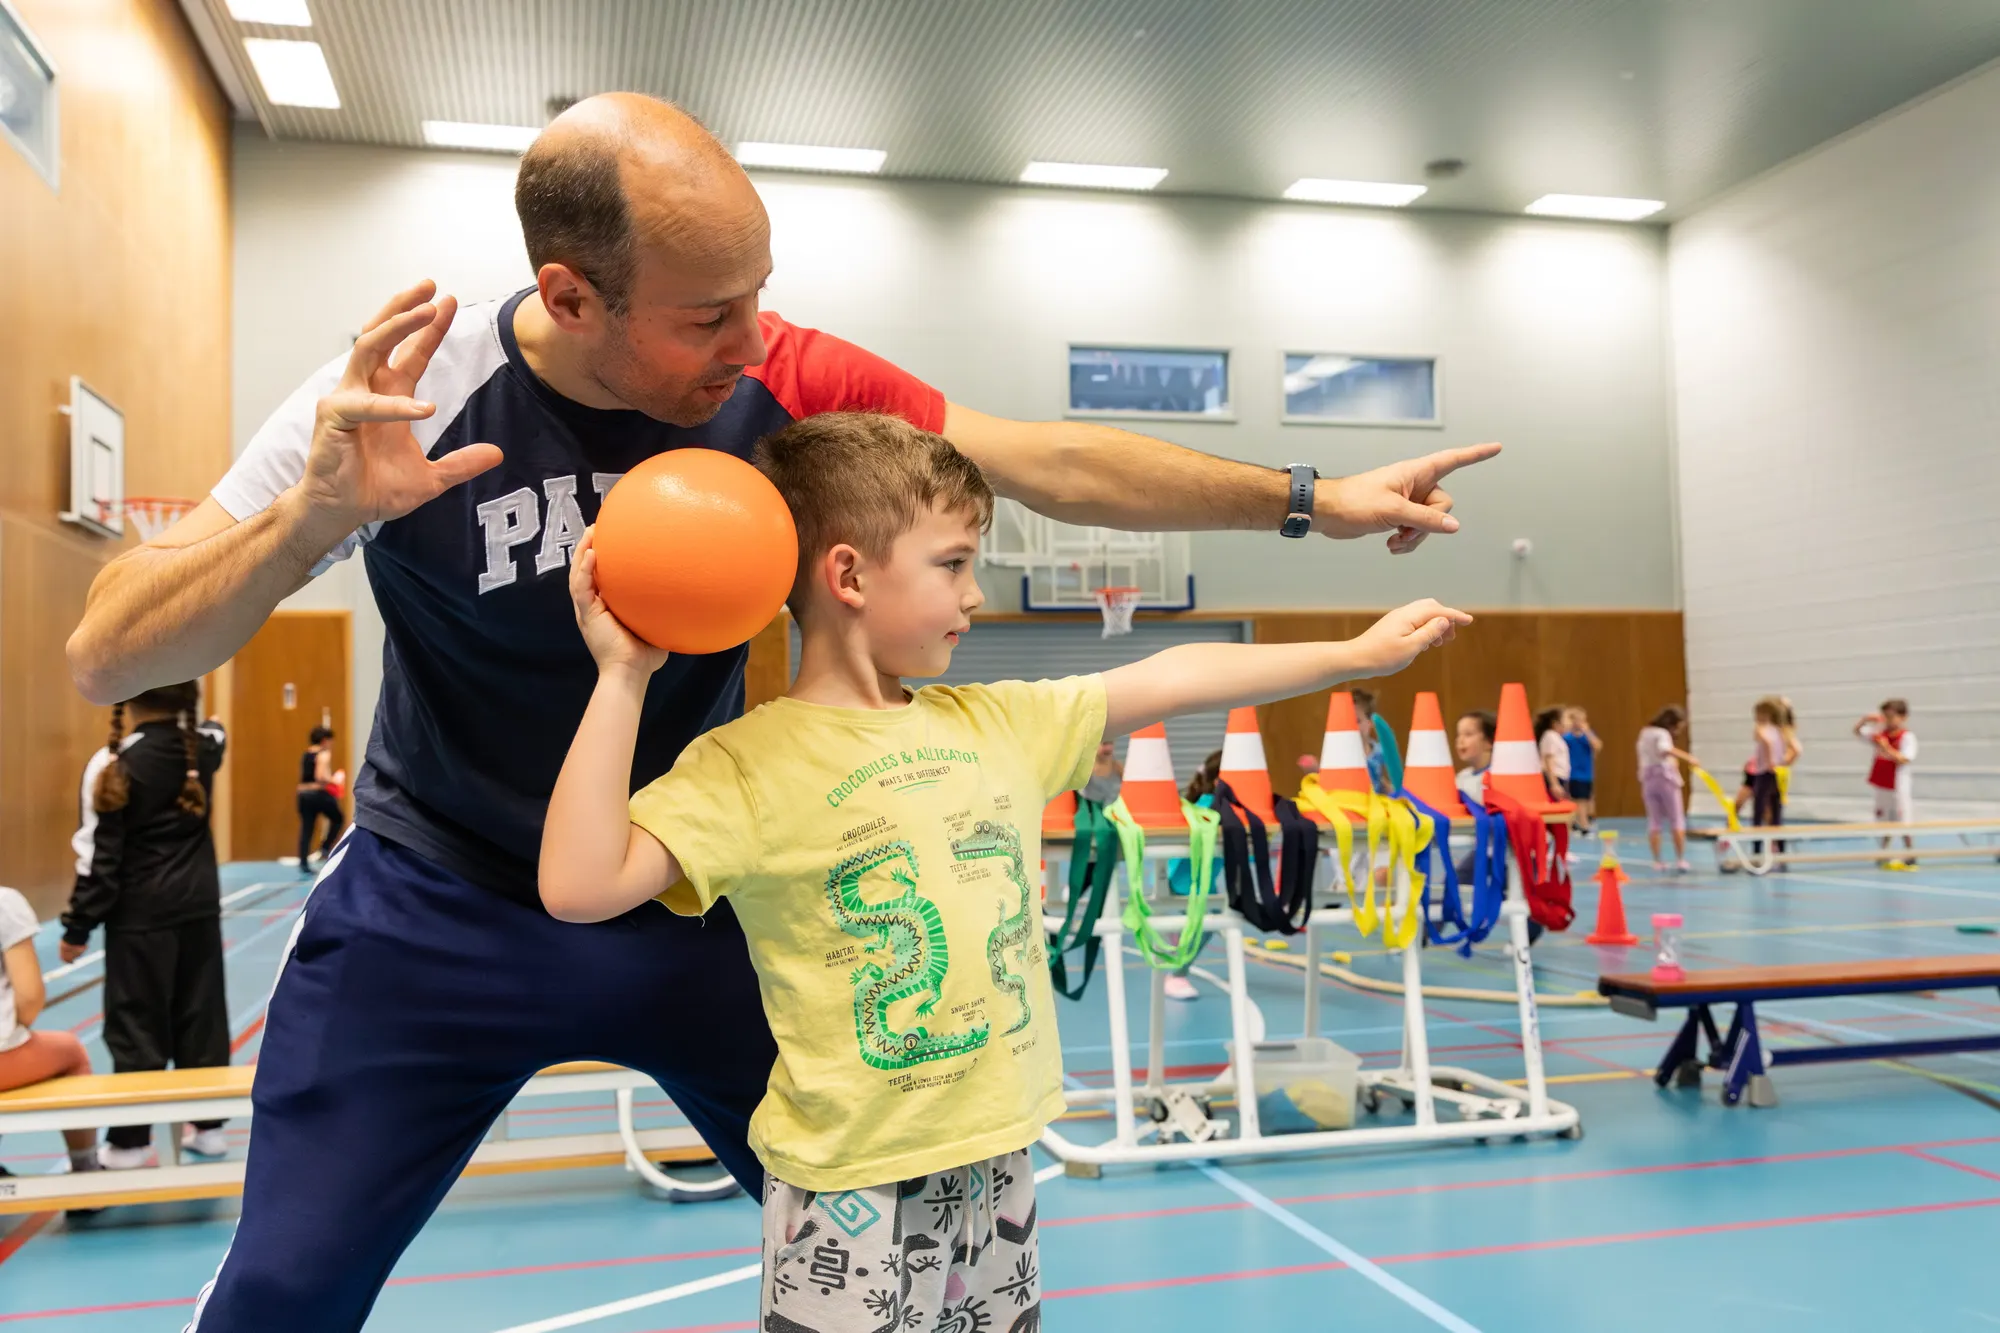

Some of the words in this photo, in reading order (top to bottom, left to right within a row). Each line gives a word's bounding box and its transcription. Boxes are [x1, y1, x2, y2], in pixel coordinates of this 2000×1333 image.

[477, 472, 625, 596] PA
[826, 753, 899, 808] CROCODILES
[900, 751, 914, 764] &
[878, 775, 902, 788] WHAT'S
[904, 773, 916, 782] THE
[916, 765, 951, 780] DIFFERENCE?
[842, 816, 887, 842] CROCODILES
[825, 945, 856, 961] HABITAT
[950, 1003, 970, 1015] SNOUT
[971, 997, 986, 1008] SHAPE
[888, 1073, 912, 1087] TEETH
